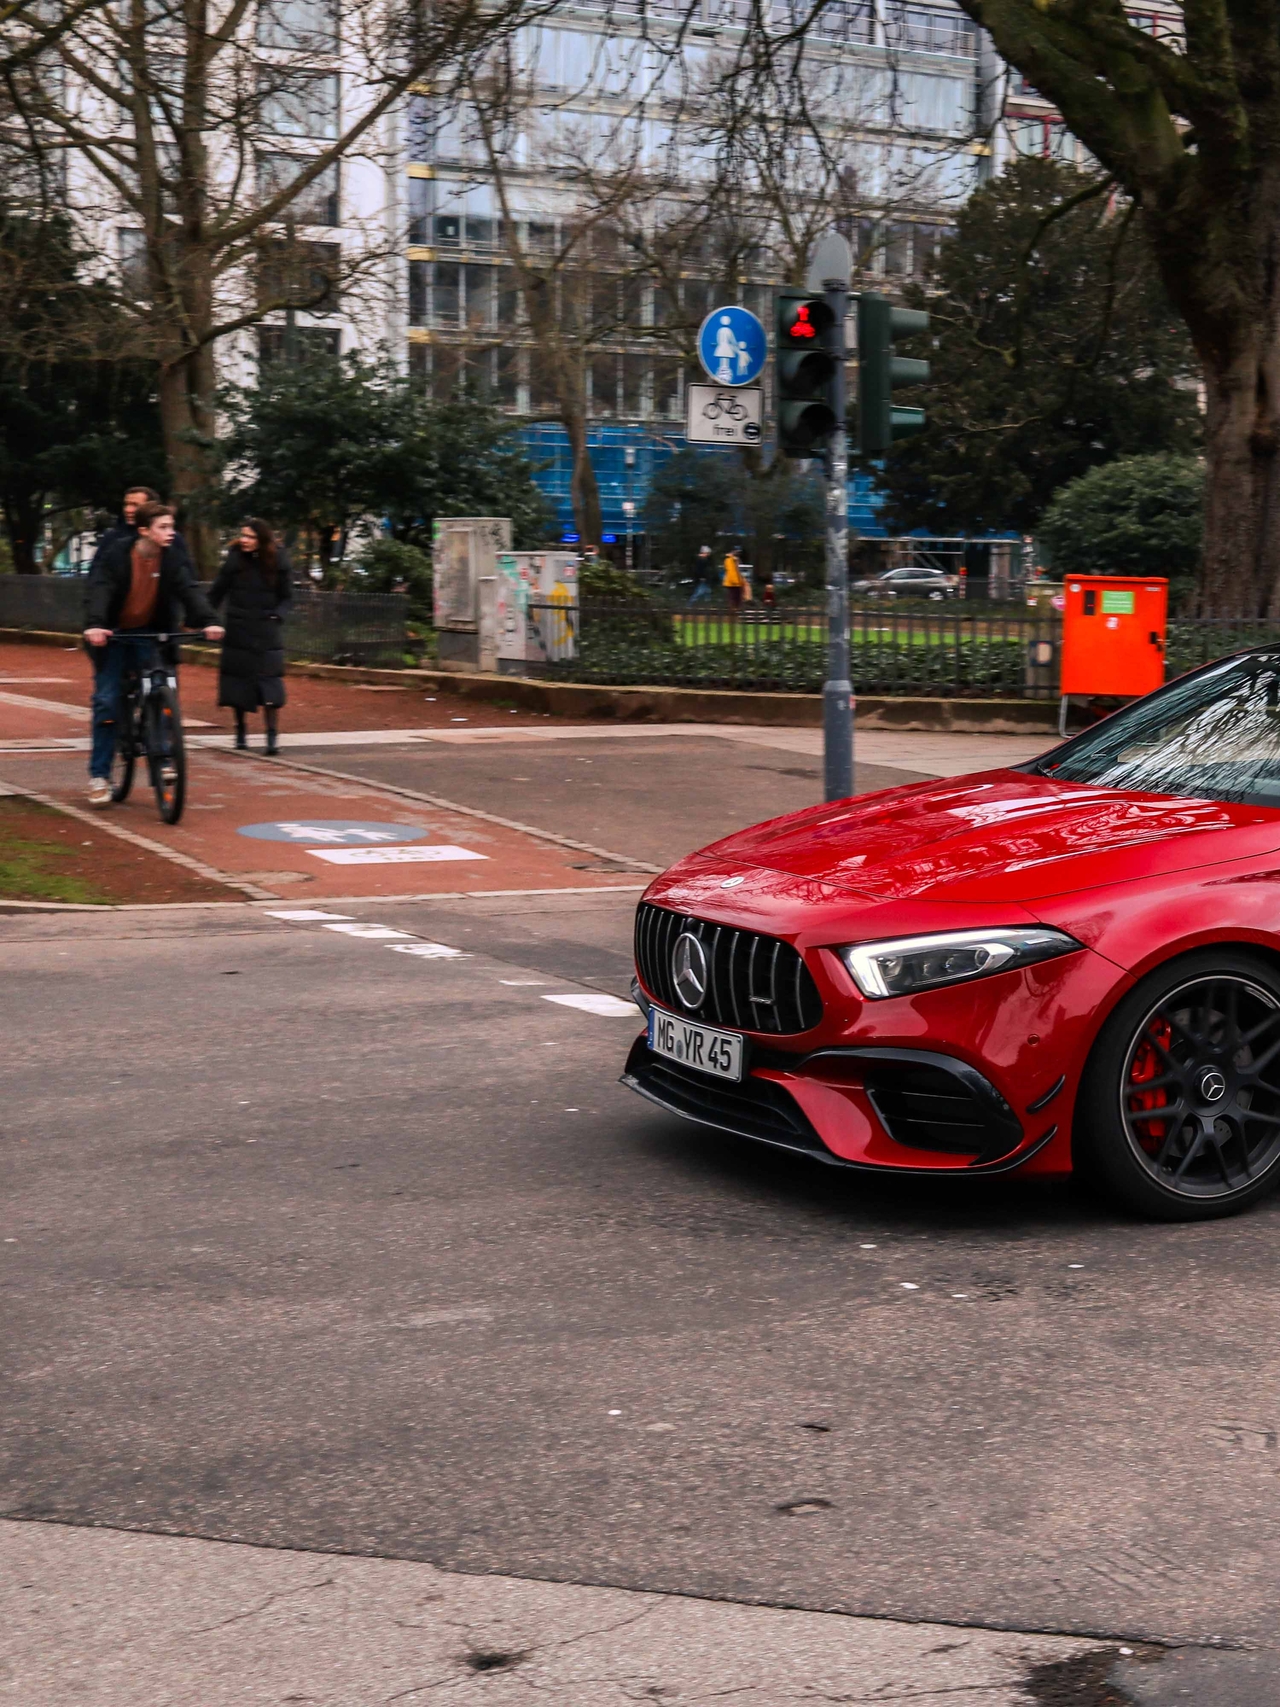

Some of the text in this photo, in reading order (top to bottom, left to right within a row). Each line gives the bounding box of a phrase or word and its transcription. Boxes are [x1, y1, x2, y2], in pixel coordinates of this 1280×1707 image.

[713, 423, 739, 436] frei
[657, 1016, 733, 1072] MG YR 45
